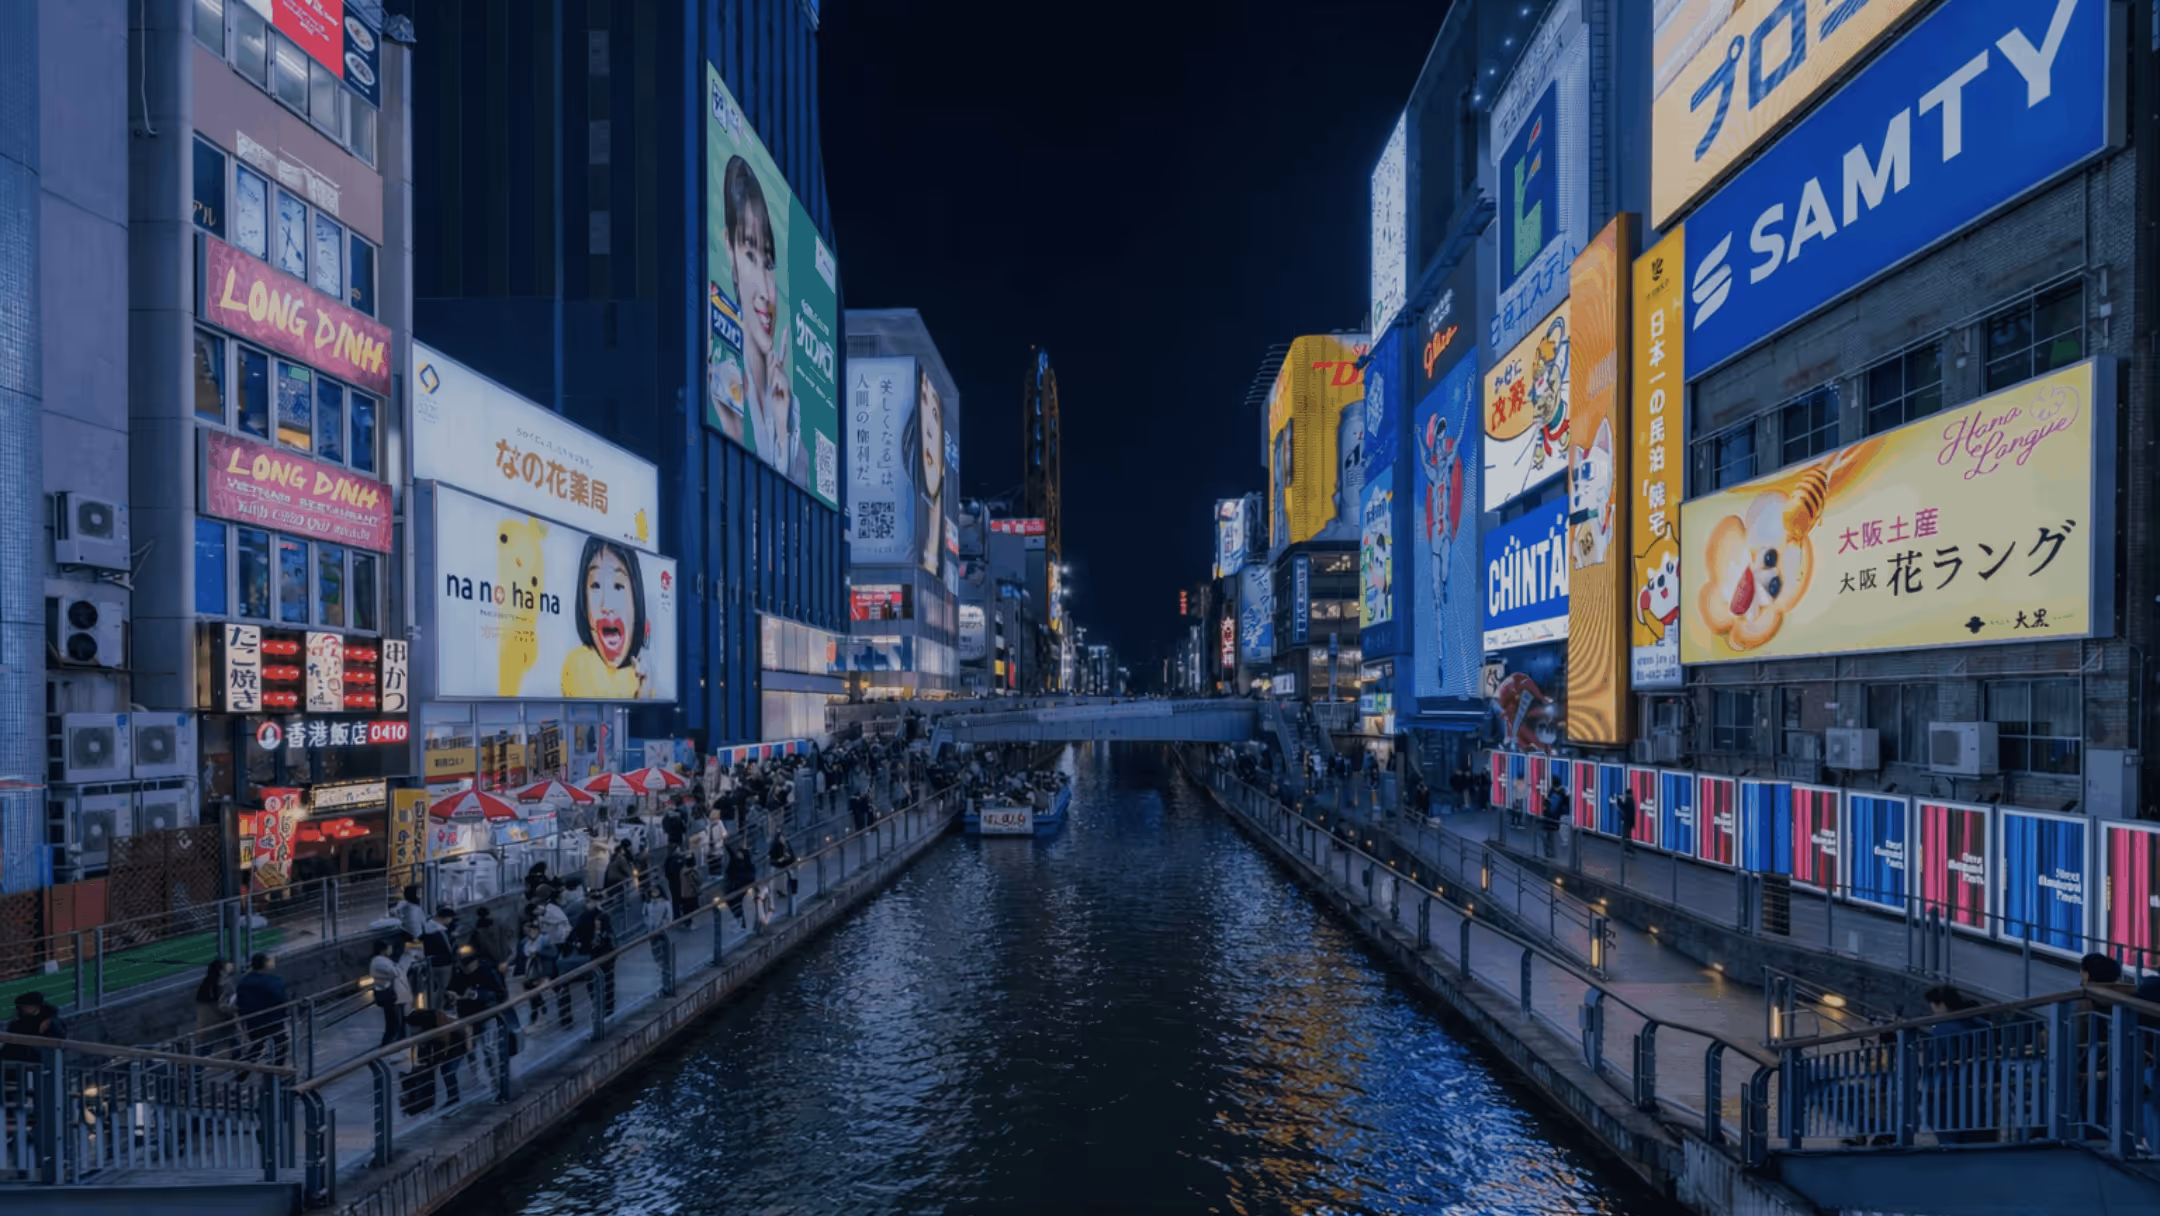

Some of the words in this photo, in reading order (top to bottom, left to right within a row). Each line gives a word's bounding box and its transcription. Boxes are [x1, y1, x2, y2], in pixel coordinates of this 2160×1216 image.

[1750, 0, 2078, 285] SAMTY
[219, 264, 308, 339] LONG
[315, 306, 385, 374] DINH
[1937, 406, 2022, 466] Hana
[227, 446, 306, 490] LONG
[313, 470, 379, 509] DINH
[494, 438, 608, 514] なの花薬局
[1488, 513, 1569, 617] CHINTA
[1838, 507, 1940, 555] 大阪土産
[228, 626, 258, 710] たこ焼き
[385, 641, 406, 711] 串かつ
[285, 720, 368, 748] 香港飯店
[370, 724, 407, 741] 0410
